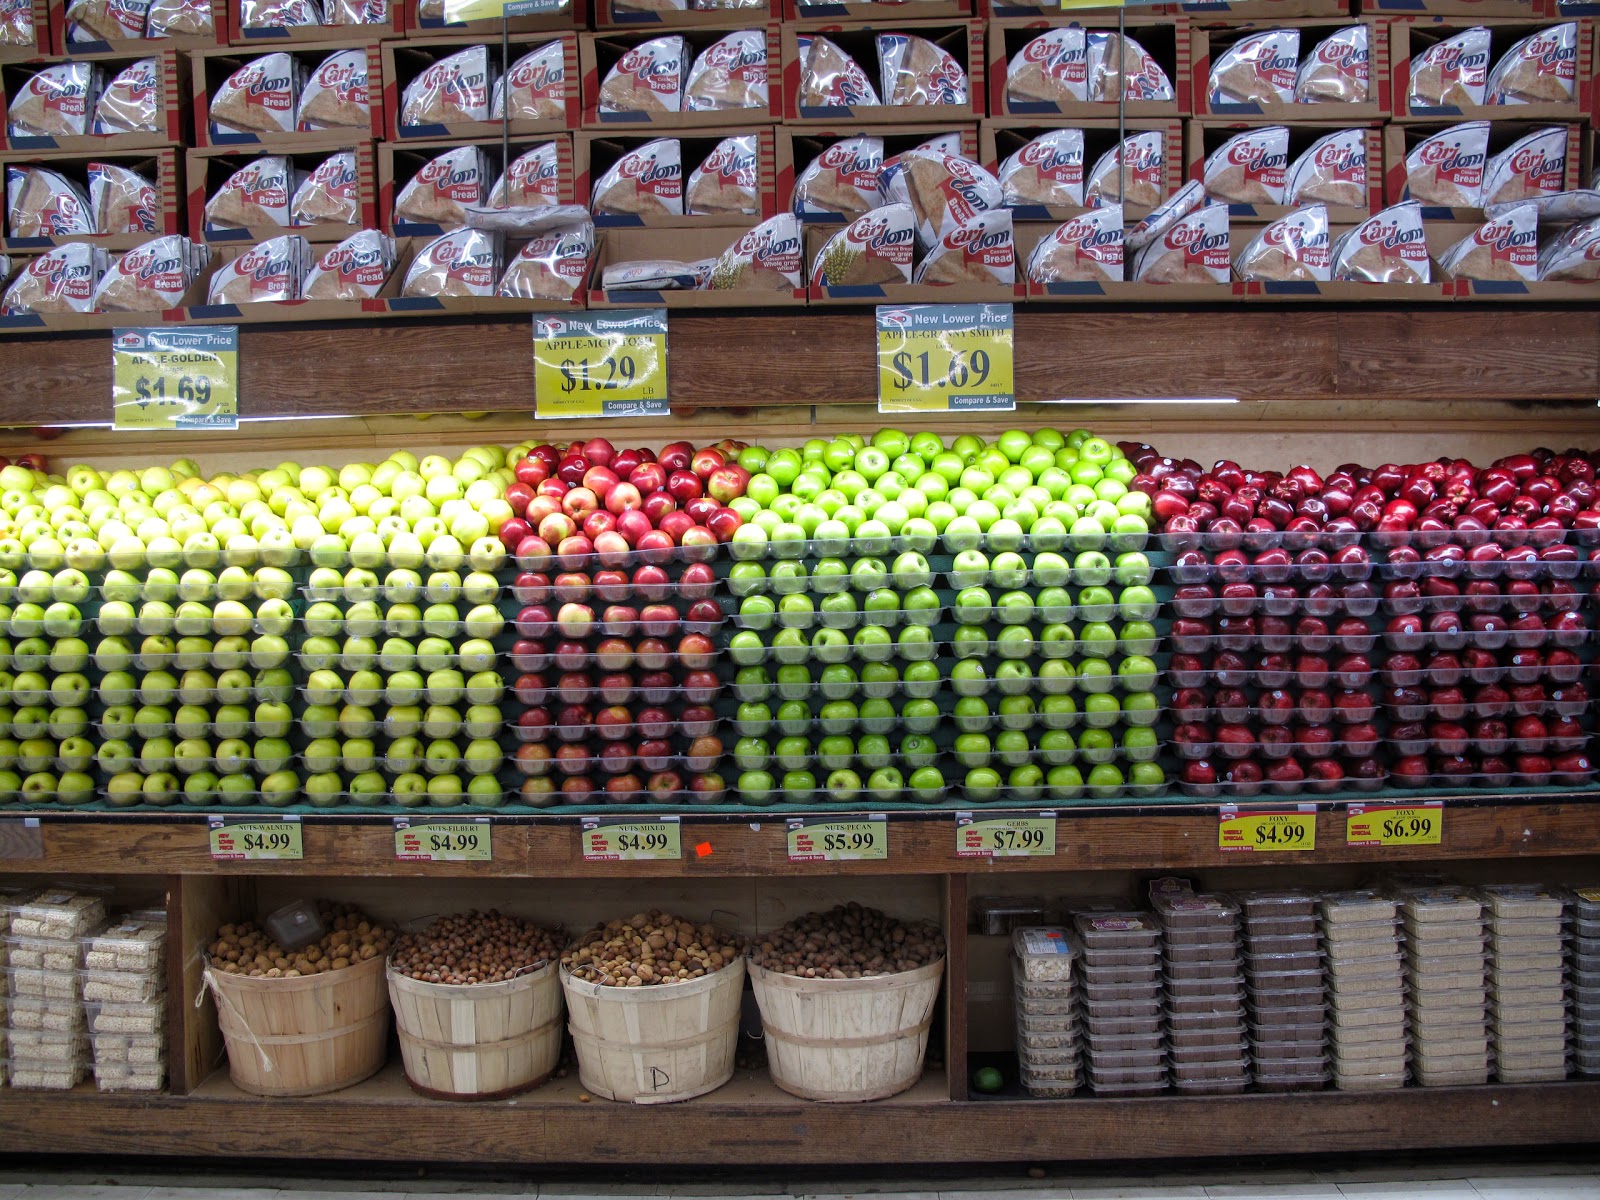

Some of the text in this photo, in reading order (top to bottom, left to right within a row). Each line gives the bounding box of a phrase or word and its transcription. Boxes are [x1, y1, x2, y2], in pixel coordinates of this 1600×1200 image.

[507, 3, 534, 12] Compare
[1446, 52, 1486, 71] dom
[1060, 70, 1086, 79] Bread
[250, 76, 291, 96] dom
[650, 81, 678, 90] Bread
[263, 97, 290, 107] Bread
[1042, 151, 1082, 171] dom
[1250, 153, 1288, 172] dom
[1441, 152, 1484, 172] dom
[1531, 157, 1564, 179] dom
[438, 167, 477, 190] dom
[641, 163, 681, 184] dom
[1055, 172, 1083, 181] Bread
[1453, 174, 1481, 183] Bread
[451, 190, 478, 199] Bread
[654, 185, 681, 194] Bread
[950, 179, 989, 212] dom
[259, 195, 286, 205] Bread
[871, 228, 913, 249] dom
[968, 231, 1010, 254] dom
[1081, 228, 1124, 250] dom
[1189, 232, 1229, 254] dom
[1385, 227, 1423, 249] dom
[1495, 230, 1536, 251] dom
[758, 237, 801, 261] dom
[897, 250, 913, 258] grain
[1400, 249, 1427, 258] Bread
[1509, 252, 1537, 262] Bread
[140, 257, 182, 279] dom
[342, 249, 381, 274] dom
[983, 254, 1013, 264] Bread
[1203, 255, 1230, 265] Bread
[255, 259, 291, 281] dom
[356, 272, 384, 282] Bread
[63, 286, 90, 296] Bread
[154, 279, 183, 288] Bread
[569, 320, 592, 331] New
[596, 319, 629, 330] Lower
[633, 318, 660, 329] Price
[915, 314, 939, 324] New
[942, 313, 975, 324] Lower
[980, 312, 1008, 323] Price
[172, 335, 232, 346] Lower Price
[970, 329, 1005, 338] SMITH
[560, 355, 636, 394] $1.29
[892, 349, 991, 392] $1.69
[135, 375, 212, 411] $1.69
[642, 387, 655, 395] LB
[608, 400, 663, 410] Compare & Save
[954, 396, 984, 406] Compare
[992, 395, 1009, 404] Save
[216, 416, 232, 424] Save
[1256, 825, 1305, 845] $4.99
[1383, 818, 1432, 839] $6.99
[244, 833, 290, 851] $4.99
[430, 834, 479, 852] $4.99
[618, 833, 668, 851] $4.99
[824, 832, 874, 851] $5.99
[994, 829, 1044, 849] $7.99
[650, 1066, 669, 1091] D
